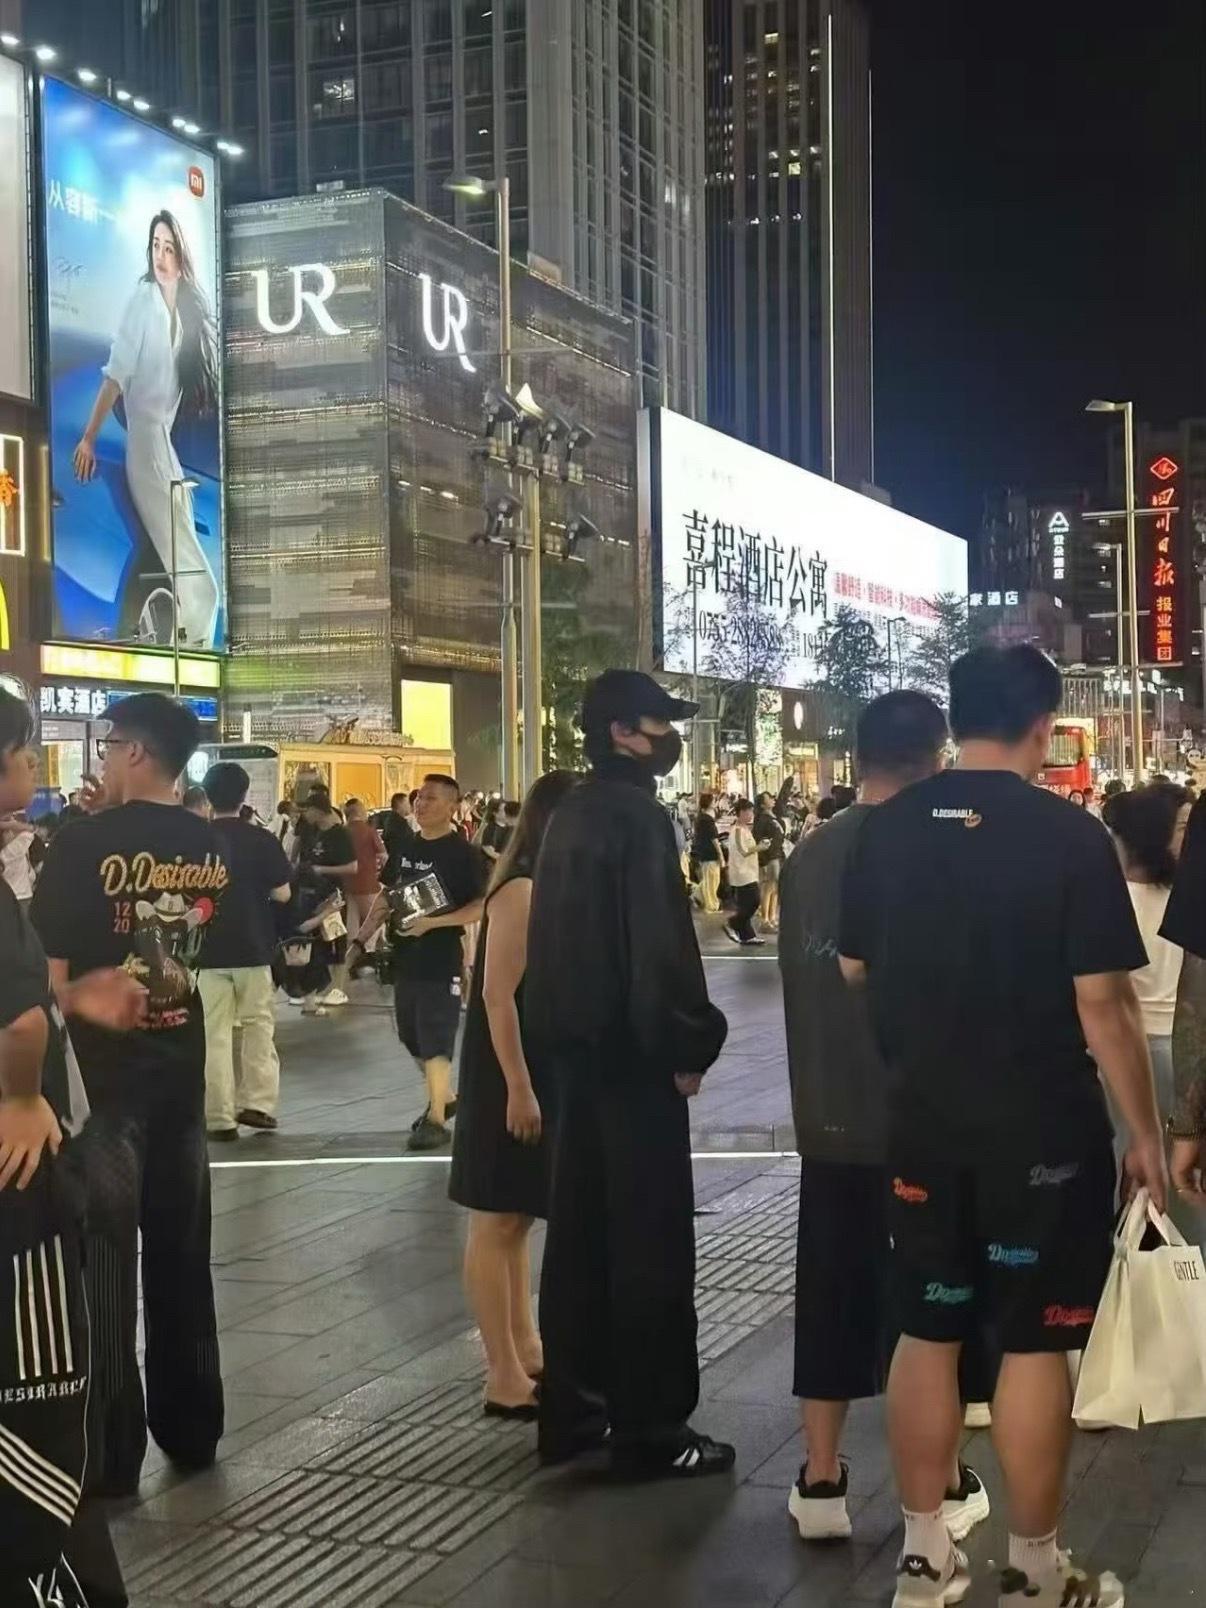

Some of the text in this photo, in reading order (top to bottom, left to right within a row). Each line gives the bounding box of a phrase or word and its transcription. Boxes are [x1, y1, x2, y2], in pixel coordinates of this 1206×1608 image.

[251, 263, 350, 336] UR
[419, 273, 477, 373] UR
[682, 509, 828, 619] 喜程酒店公寓
[1152, 487, 1176, 661] 四川日报 报业集团
[113, 918, 130, 934] 20
[114, 901, 131, 917] 12
